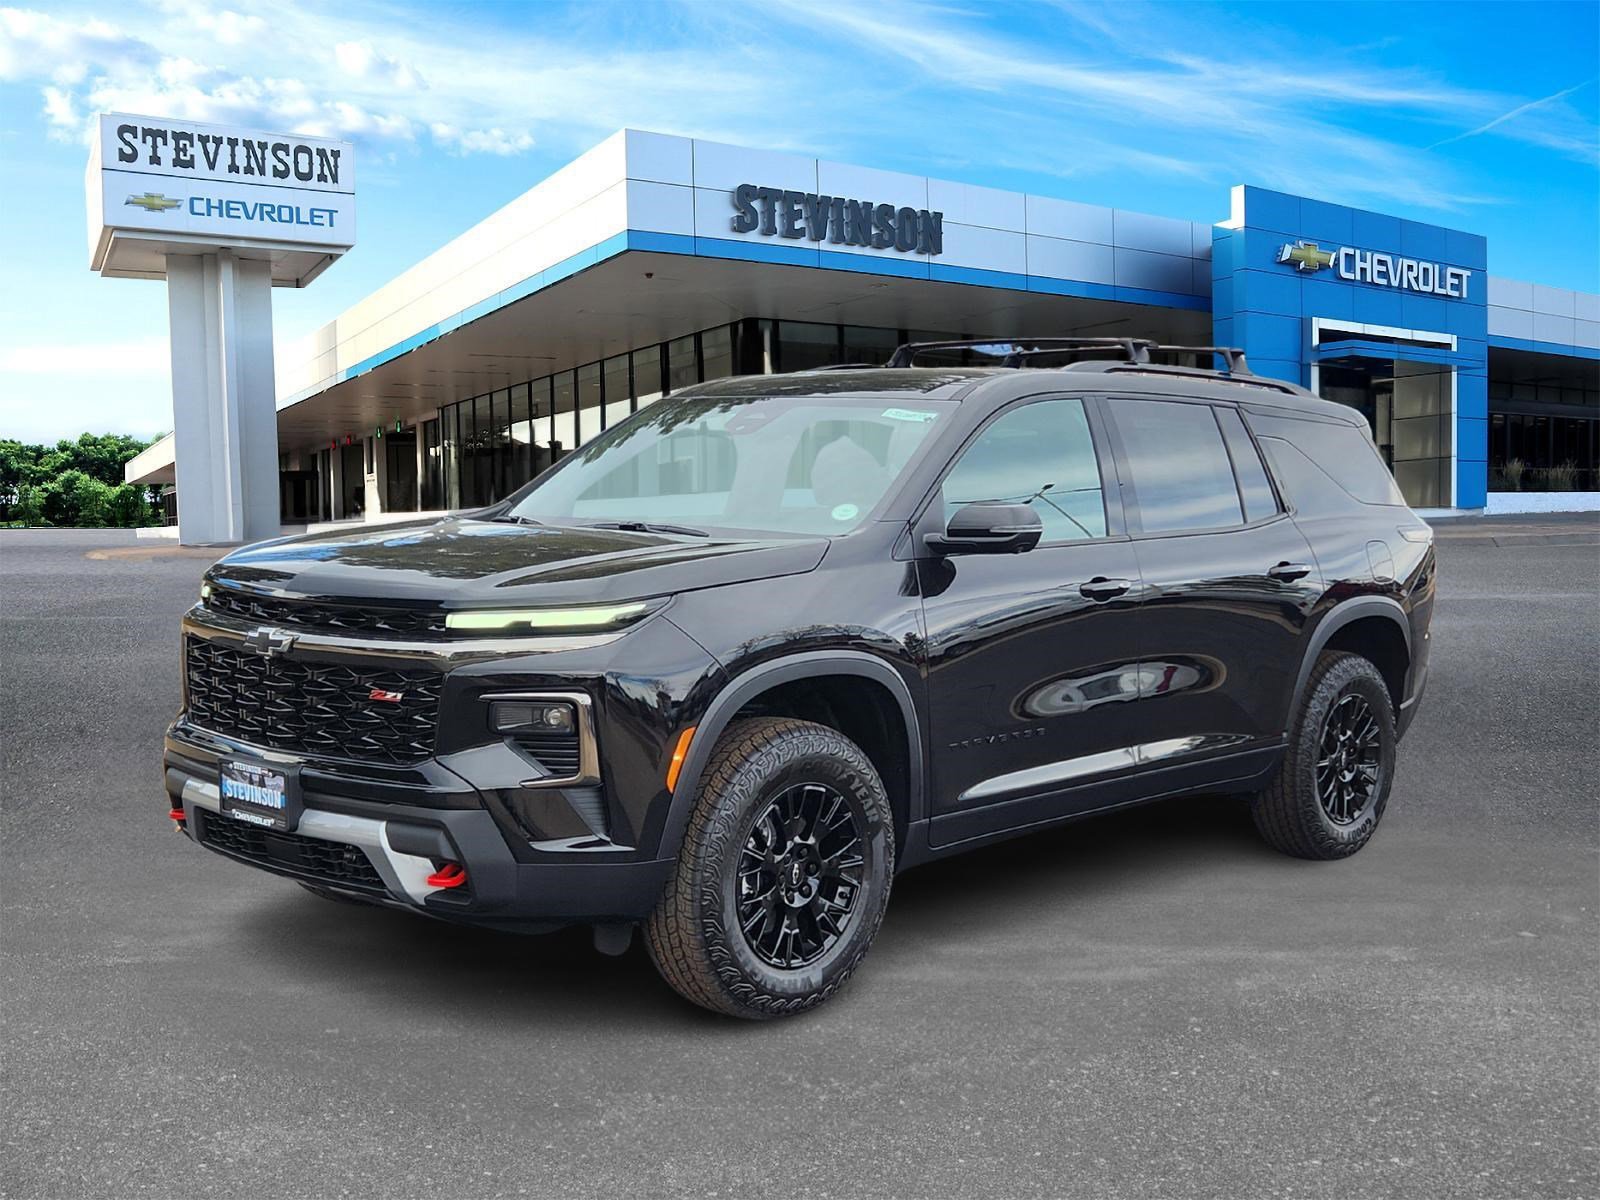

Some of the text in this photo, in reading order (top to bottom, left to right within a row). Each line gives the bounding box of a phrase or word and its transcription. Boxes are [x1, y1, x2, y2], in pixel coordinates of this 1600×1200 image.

[117, 124, 341, 184] STEVINSON
[189, 197, 338, 227] CHEVROLET
[731, 184, 943, 255] STEVINSON
[1339, 246, 1471, 298] CHEVROLET
[226, 779, 281, 809] STEVINSON
[234, 811, 272, 826] CHEVROLET
